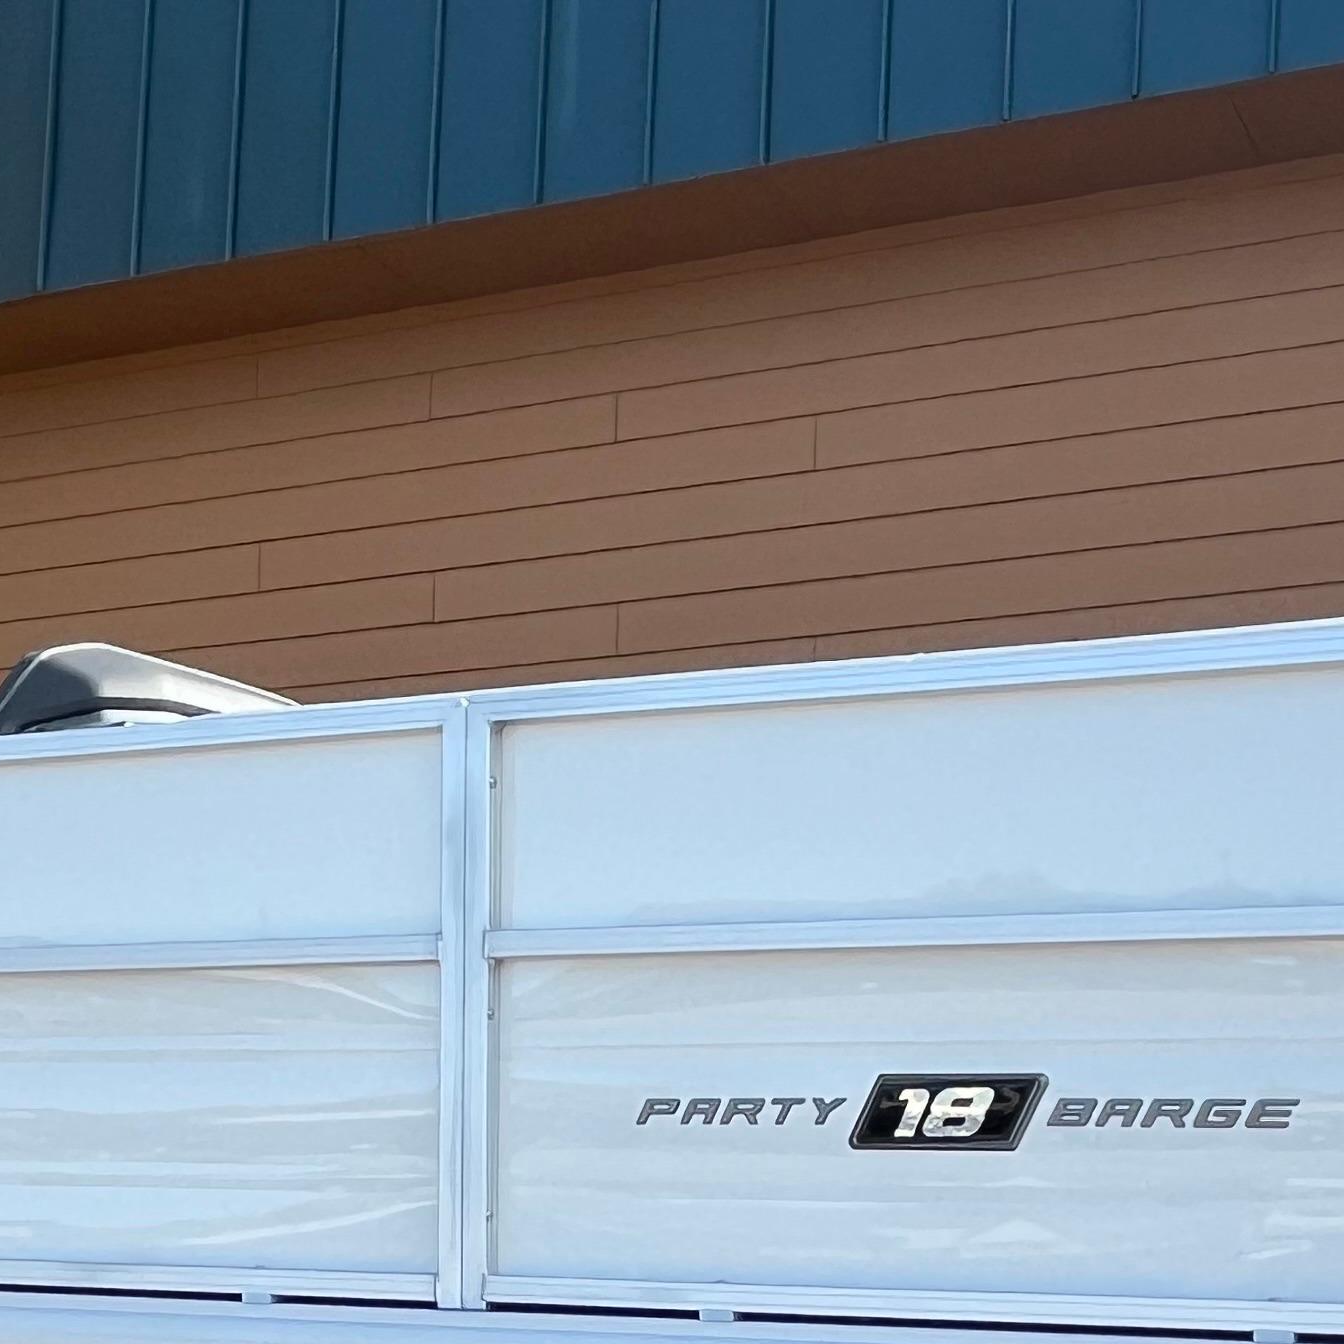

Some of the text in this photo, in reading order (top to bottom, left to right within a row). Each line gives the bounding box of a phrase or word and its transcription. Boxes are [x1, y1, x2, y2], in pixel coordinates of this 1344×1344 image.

[635, 1087, 1301, 1137] PARTY 18 BARGE
